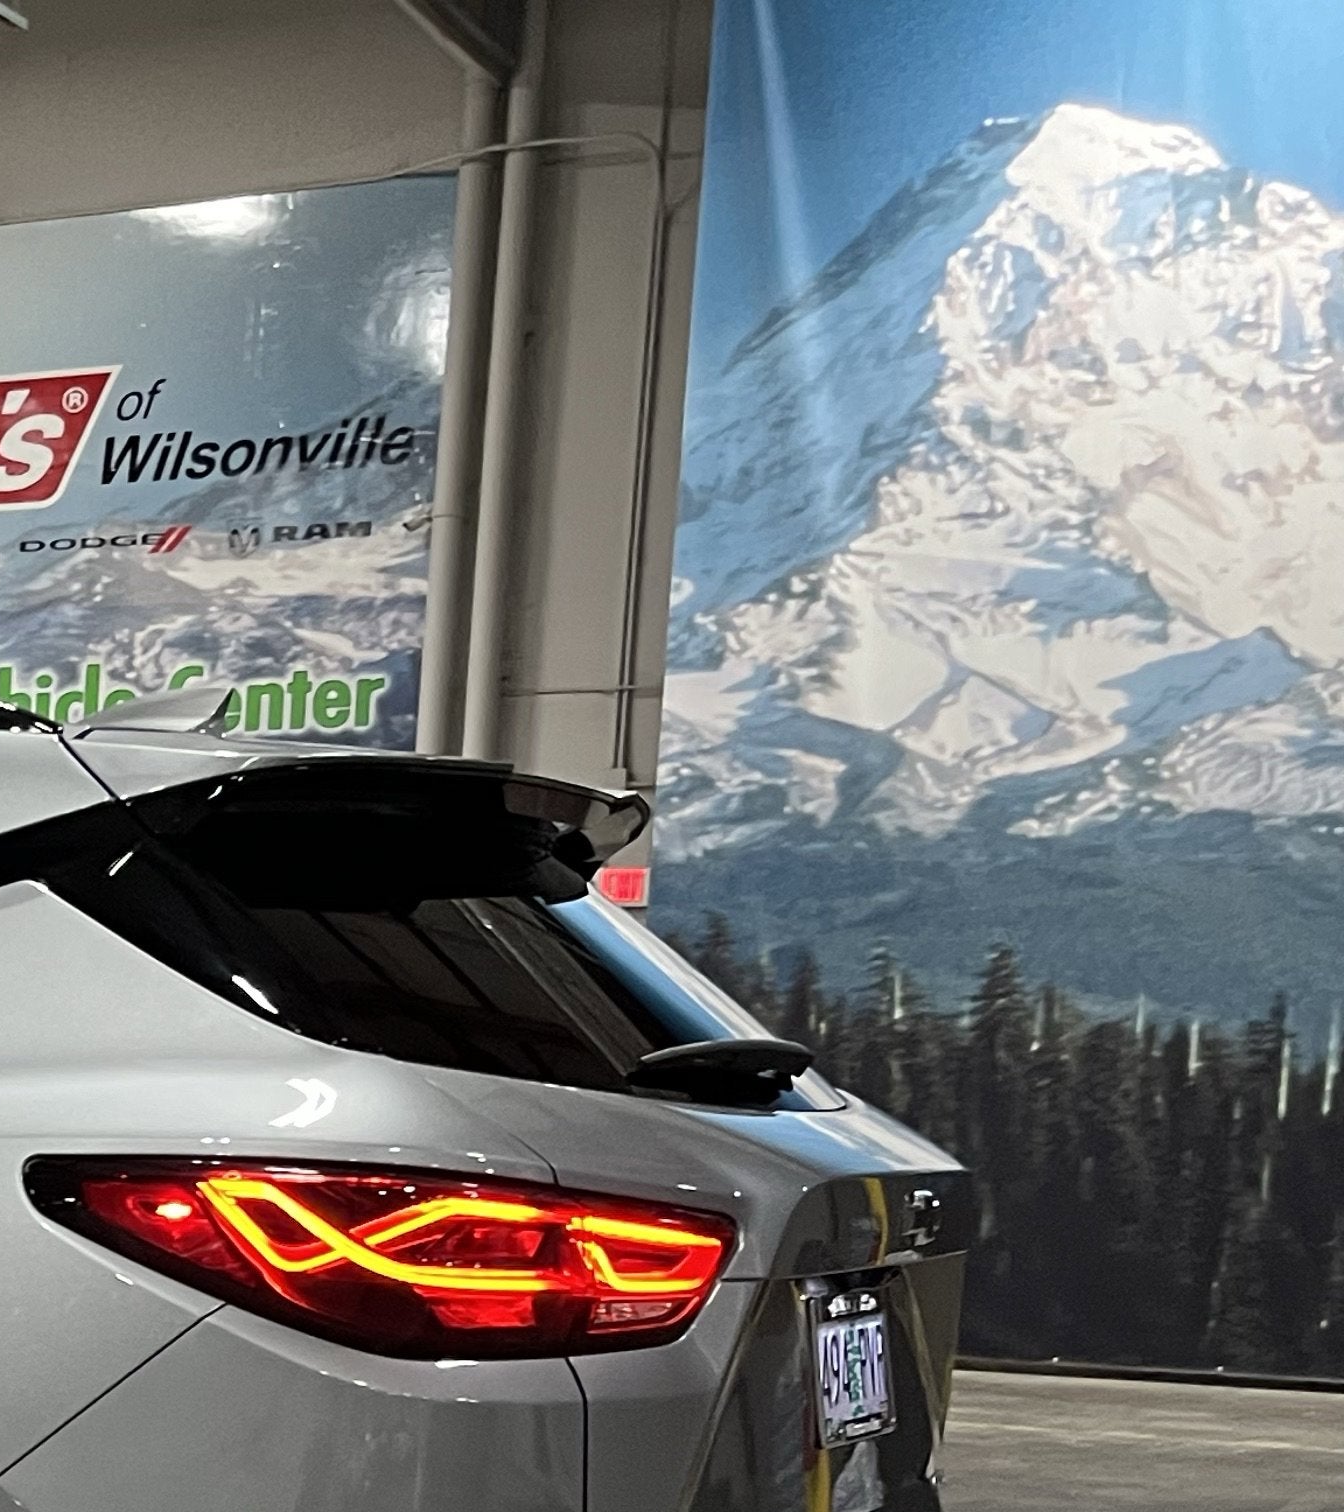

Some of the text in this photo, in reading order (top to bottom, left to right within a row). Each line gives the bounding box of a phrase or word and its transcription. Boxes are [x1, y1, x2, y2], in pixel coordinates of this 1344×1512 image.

[116, 379, 166, 421] of
[101, 415, 415, 484] Wilsonville
[19, 532, 162, 553] DODGE
[272, 521, 372, 542] RAM
